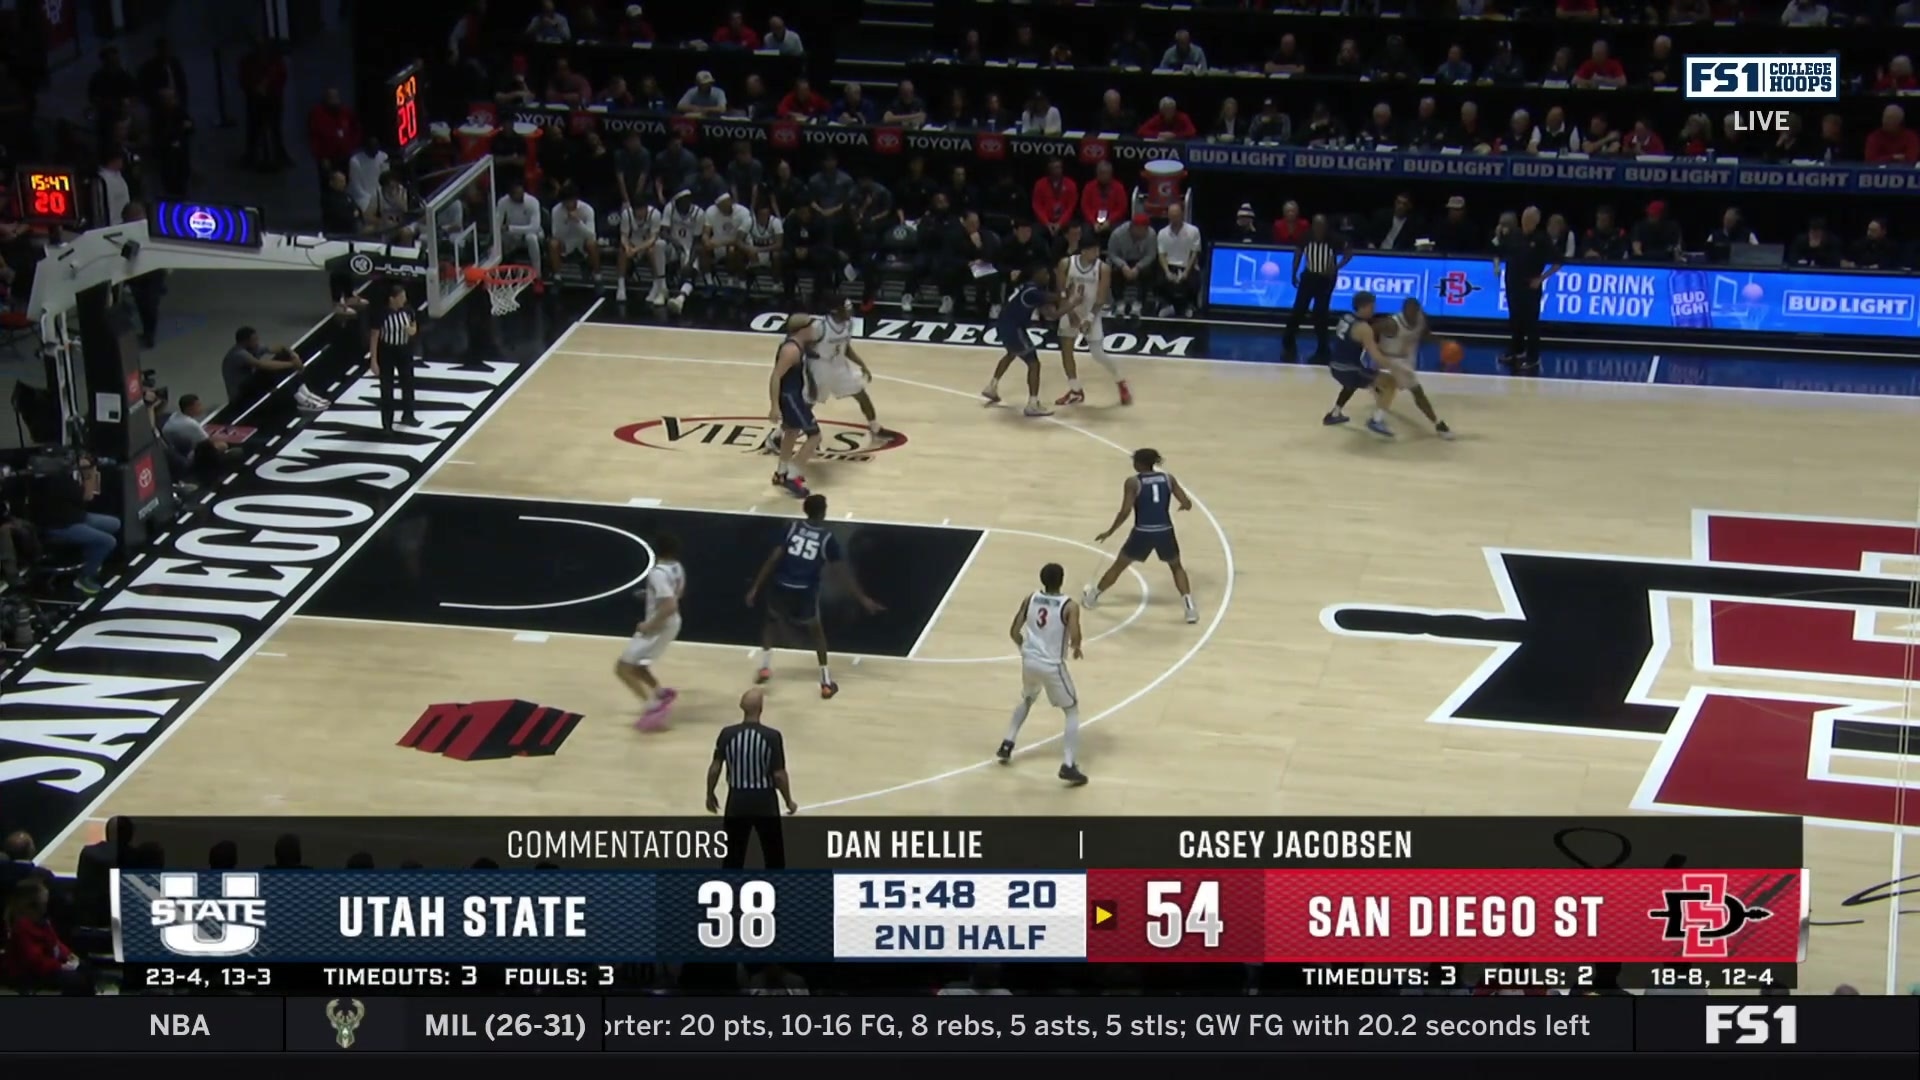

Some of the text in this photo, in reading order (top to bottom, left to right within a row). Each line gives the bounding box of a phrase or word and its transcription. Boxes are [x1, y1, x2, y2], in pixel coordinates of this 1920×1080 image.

[398, 100, 418, 146] 20
[604, 118, 666, 136] TOYOTA
[703, 124, 767, 141] TOYOTA
[805, 130, 868, 146] TOYOTA
[907, 135, 973, 152] TOYOTA
[1011, 141, 1076, 157] TOYOTA
[1114, 145, 1181, 162] TOYOTA
[1190, 149, 1287, 168] BUD LIGHT
[1295, 153, 1395, 172] BUD LIGHT
[1404, 156, 1504, 177] BUD LIGHT
[1513, 161, 1616, 181] BUD LIGHT
[31, 174, 70, 191] 15:47
[1625, 167, 1731, 185] BUD LIGHT
[1740, 170, 1850, 188] BUD LIGHT
[1859, 173, 1905, 190] BUD
[35, 191, 66, 214] 20
[1353, 276, 1415, 294] LIGHT
[1555, 272, 1582, 292] TO
[1587, 273, 1655, 296] DRINK
[1555, 293, 1582, 314] TO
[1588, 295, 1655, 318] ENJOY
[1673, 291, 1706, 305] BUD
[1789, 295, 1909, 315] BUD LIGHT
[1151, 483, 1161, 503] 1
[787, 534, 821, 561] 35
[0, 360, 521, 793] SAN DIEGO STATE
[1036, 607, 1049, 629] 3
